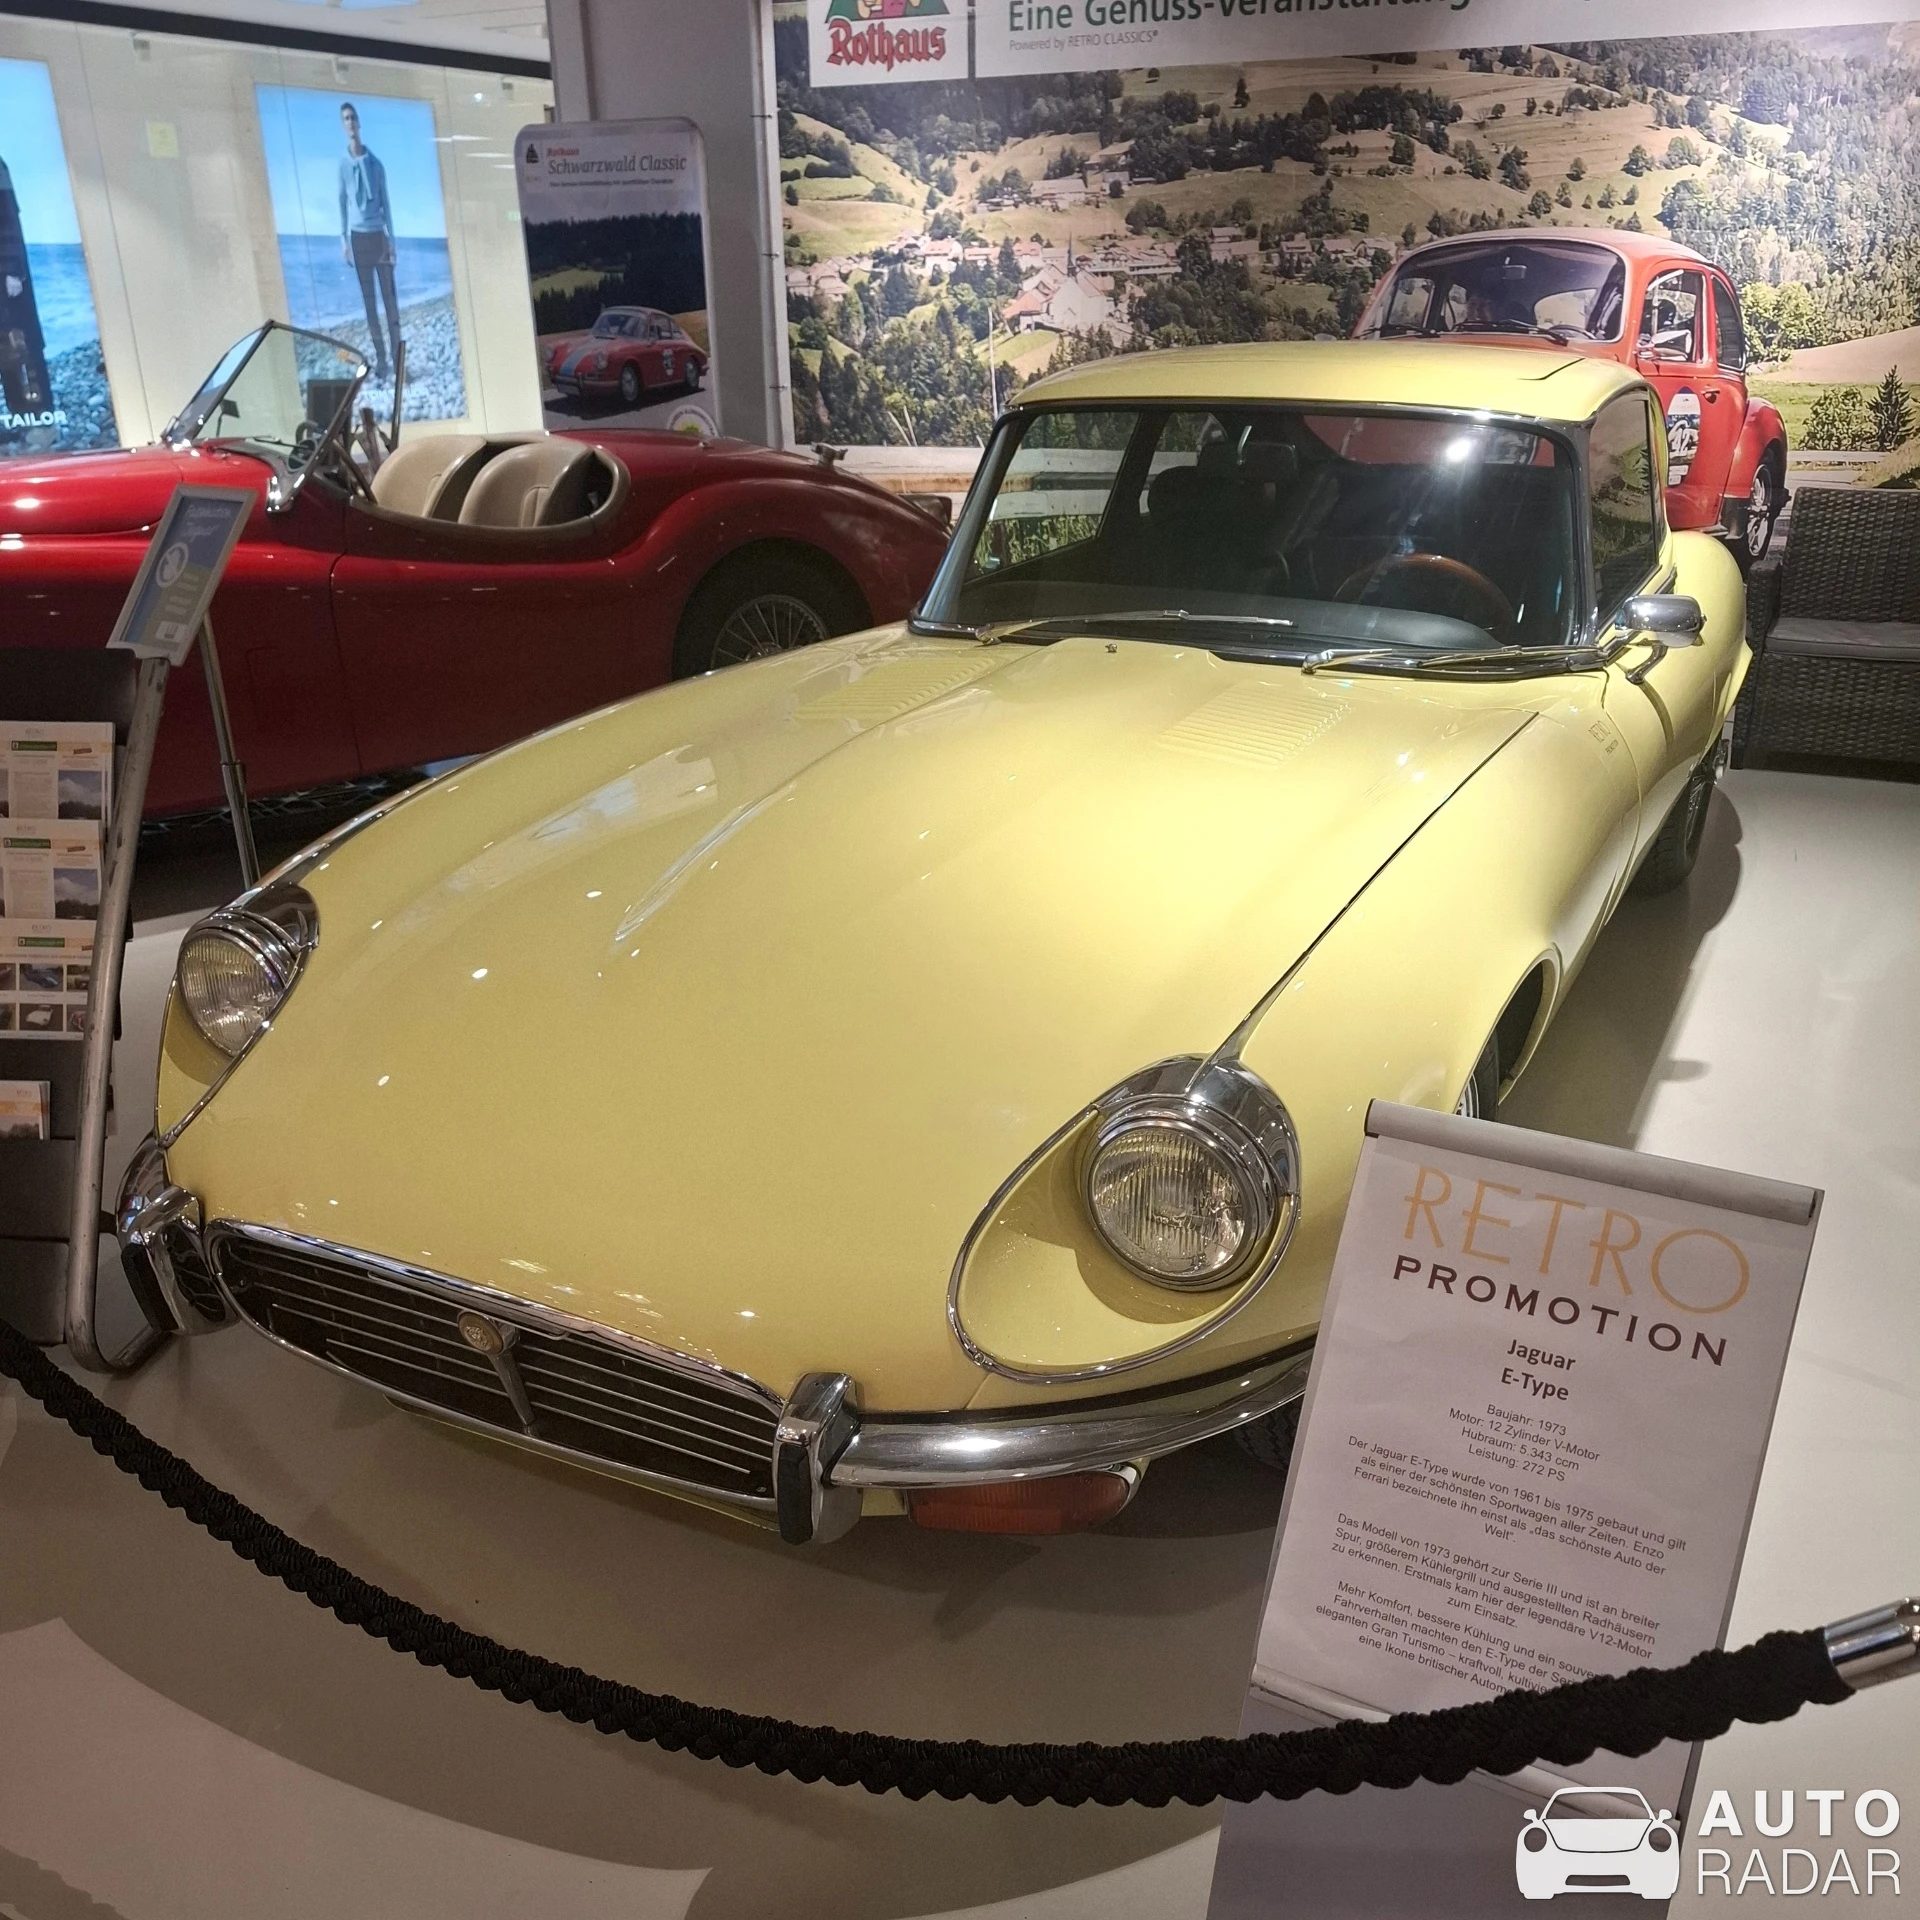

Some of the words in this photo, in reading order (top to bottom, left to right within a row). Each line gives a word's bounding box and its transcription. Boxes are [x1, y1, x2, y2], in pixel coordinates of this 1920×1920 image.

[1009, 0, 1073, 31] Eine
[1009, 39, 1051, 51] Powered
[1053, 38, 1065, 51] by
[1066, 35, 1101, 46] RETRO
[826, 18, 947, 72] Rothaus
[548, 155, 637, 174] Schwarzwald
[640, 154, 688, 171] Classic
[0, 410, 68, 430] TAILOR
[1403, 1165, 1750, 1315] RETRO
[1392, 1254, 1728, 1368] PROMOTION
[1506, 1339, 1577, 1372] Jaguar
[1500, 1367, 1570, 1402] E-Type
[1448, 1407, 1485, 1428] Motor:
[1488, 1420, 1503, 1433] 12
[1503, 1424, 1552, 1447] Zylinder
[1553, 1438, 1601, 1462] V-Motor
[1460, 1426, 1517, 1453] Hubraum:
[1518, 1444, 1553, 1463] 5.343
[1554, 1457, 1580, 1472] ccm
[1485, 1404, 1535, 1428] Baujahr:
[1538, 1420, 1567, 1437] 1973
[1467, 1443, 1520, 1470] Leistung:
[1521, 1460, 1546, 1477] 272
[1546, 1468, 1566, 1483] PS
[1347, 1435, 1369, 1451] Der
[1369, 1443, 1409, 1463] Jaguar
[1409, 1455, 1450, 1476] E-Type
[1451, 1470, 1487, 1488] wurde
[1488, 1482, 1510, 1496] von
[1513, 1488, 1541, 1505] 1961
[1543, 1497, 1562, 1512] bis
[1565, 1504, 1595, 1522] 1975
[1595, 1516, 1640, 1537] gebaut
[1641, 1530, 1666, 1545] und
[1666, 1538, 1687, 1552] gilt
[1353, 1466, 1391, 1487] Ferrari
[1391, 1478, 1458, 1509] bezeichnete
[1459, 1500, 1478, 1515] ihn
[1479, 1509, 1509, 1525] einst
[1509, 1519, 1528, 1532] als
[1557, 1534, 1613, 1559] schönste
[1612, 1551, 1643, 1569] Auto
[1644, 1562, 1667, 1576] der
[1359, 1456, 1377, 1468] als
[1378, 1462, 1408, 1477] einer
[1408, 1470, 1428, 1484] der
[1428, 1478, 1487, 1503] schönsten
[1488, 1495, 1558, 1526] Sportwagen
[1559, 1519, 1587, 1535] aller
[1587, 1526, 1629, 1549] Zeiten.
[1632, 1540, 1665, 1560] Enzo
[1334, 1527, 1363, 1547] Spur,
[1364, 1539, 1419, 1564] größerem
[1420, 1556, 1478, 1584] Kühlergrill
[1478, 1577, 1502, 1592] und
[1502, 1586, 1580, 1619] ausgestellten
[1581, 1611, 1656, 1646] Radhäusern
[1337, 1513, 1360, 1529] Das
[1360, 1521, 1399, 1542] Modell
[1399, 1535, 1421, 1550] von
[1423, 1542, 1451, 1560] 1973
[1452, 1554, 1490, 1573] gehört
[1490, 1566, 1511, 1580] zur
[1512, 1572, 1544, 1591] Serie
[1559, 1590, 1584, 1605] und
[1620, 1608, 1661, 1631] breiter
[1330, 1542, 1346, 1554] zu
[1347, 1548, 1401, 1573] erkennen.
[1403, 1565, 1453, 1591] Erstmals
[1454, 1582, 1480, 1599] kam
[1480, 1591, 1505, 1608] hier
[1505, 1601, 1527, 1615] der
[1526, 1607, 1587, 1637] legendäre
[1589, 1628, 1654, 1660] V12-Motor
[1337, 1580, 1367, 1599] Mehr
[1367, 1590, 1414, 1617] Komfort,
[1416, 1608, 1462, 1632] bessere
[1463, 1624, 1511, 1653] Kühlung
[1512, 1644, 1536, 1660] und
[1537, 1653, 1556, 1667] ein
[1558, 1661, 1601, 1679] souve
[1445, 1597, 1472, 1612] zum
[1473, 1604, 1519, 1629] Einsatz.
[1315, 1605, 1369, 1630] eleganten
[1370, 1622, 1399, 1641] Gran
[1401, 1632, 1446, 1657] Turismo
[1457, 1652, 1504, 1681] kraftvoll,
[1332, 1594, 1409, 1629] Fahrverhalten
[1409, 1623, 1459, 1647] machten
[1460, 1640, 1483, 1655] den
[1484, 1647, 1527, 1671] E-Type
[1527, 1665, 1549, 1679] der
[1551, 1671, 1574, 1686] Ser
[1357, 1635, 1383, 1650] eine
[1384, 1642, 1416, 1662] Ikone
[1417, 1653, 1470, 1681] britischer
[1470, 1673, 1508, 1694] Autom
